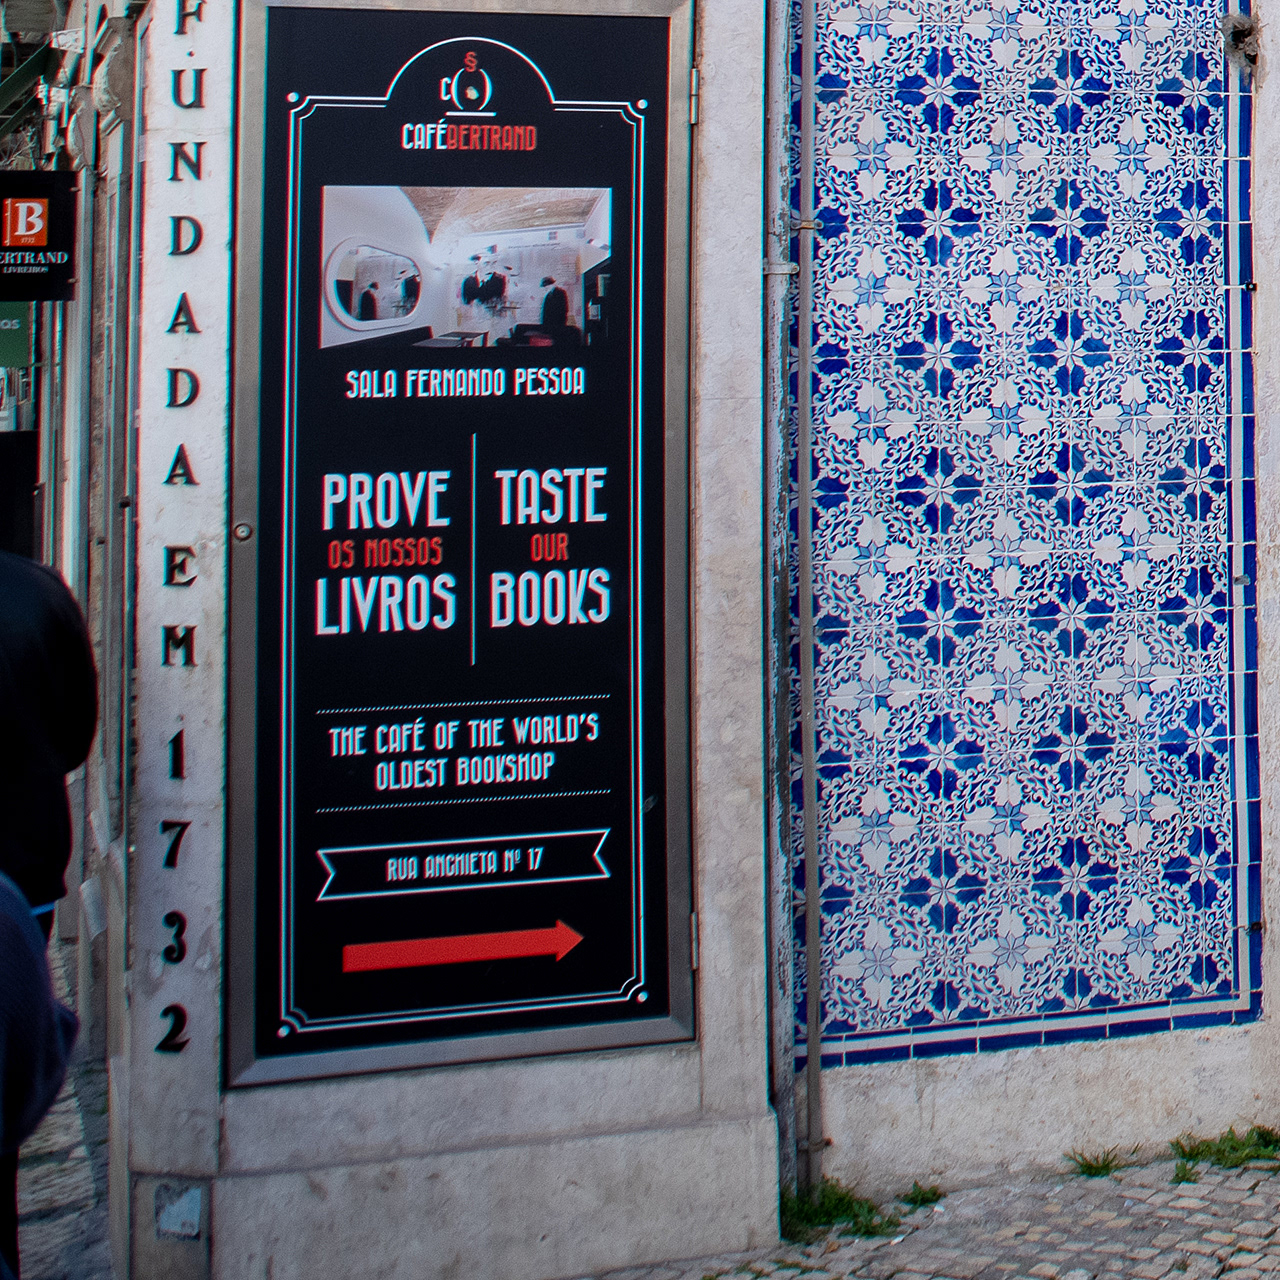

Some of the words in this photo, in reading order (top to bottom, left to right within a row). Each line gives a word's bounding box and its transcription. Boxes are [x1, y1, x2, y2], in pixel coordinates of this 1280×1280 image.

[14, 202, 44, 235] B
[0, 251, 69, 264] ERTRAND
[345, 369, 396, 399] SALA
[405, 368, 506, 398] FERNANDO
[514, 367, 586, 395] PESSOA
[322, 471, 451, 531] PROVE
[494, 467, 608, 525] TASTE
[328, 539, 354, 569] OS
[364, 536, 443, 568] NOSSOS
[531, 533, 569, 562] OUR
[161, 545, 199, 667] EM
[315, 573, 457, 636] LIVROS
[490, 568, 611, 628] BOOKS
[329, 726, 367, 757] THE
[374, 717, 426, 755] CAFÉ
[434, 720, 461, 750] OF
[467, 718, 505, 748] THE
[512, 713, 600, 745] WORLD'S
[374, 758, 448, 791] OLDEST
[456, 752, 556, 785] BOOKSHOP
[386, 857, 418, 882] RUA
[424, 850, 498, 879] ANCHIETA
[527, 847, 545, 871] 17
[154, 728, 192, 1054] 1732
